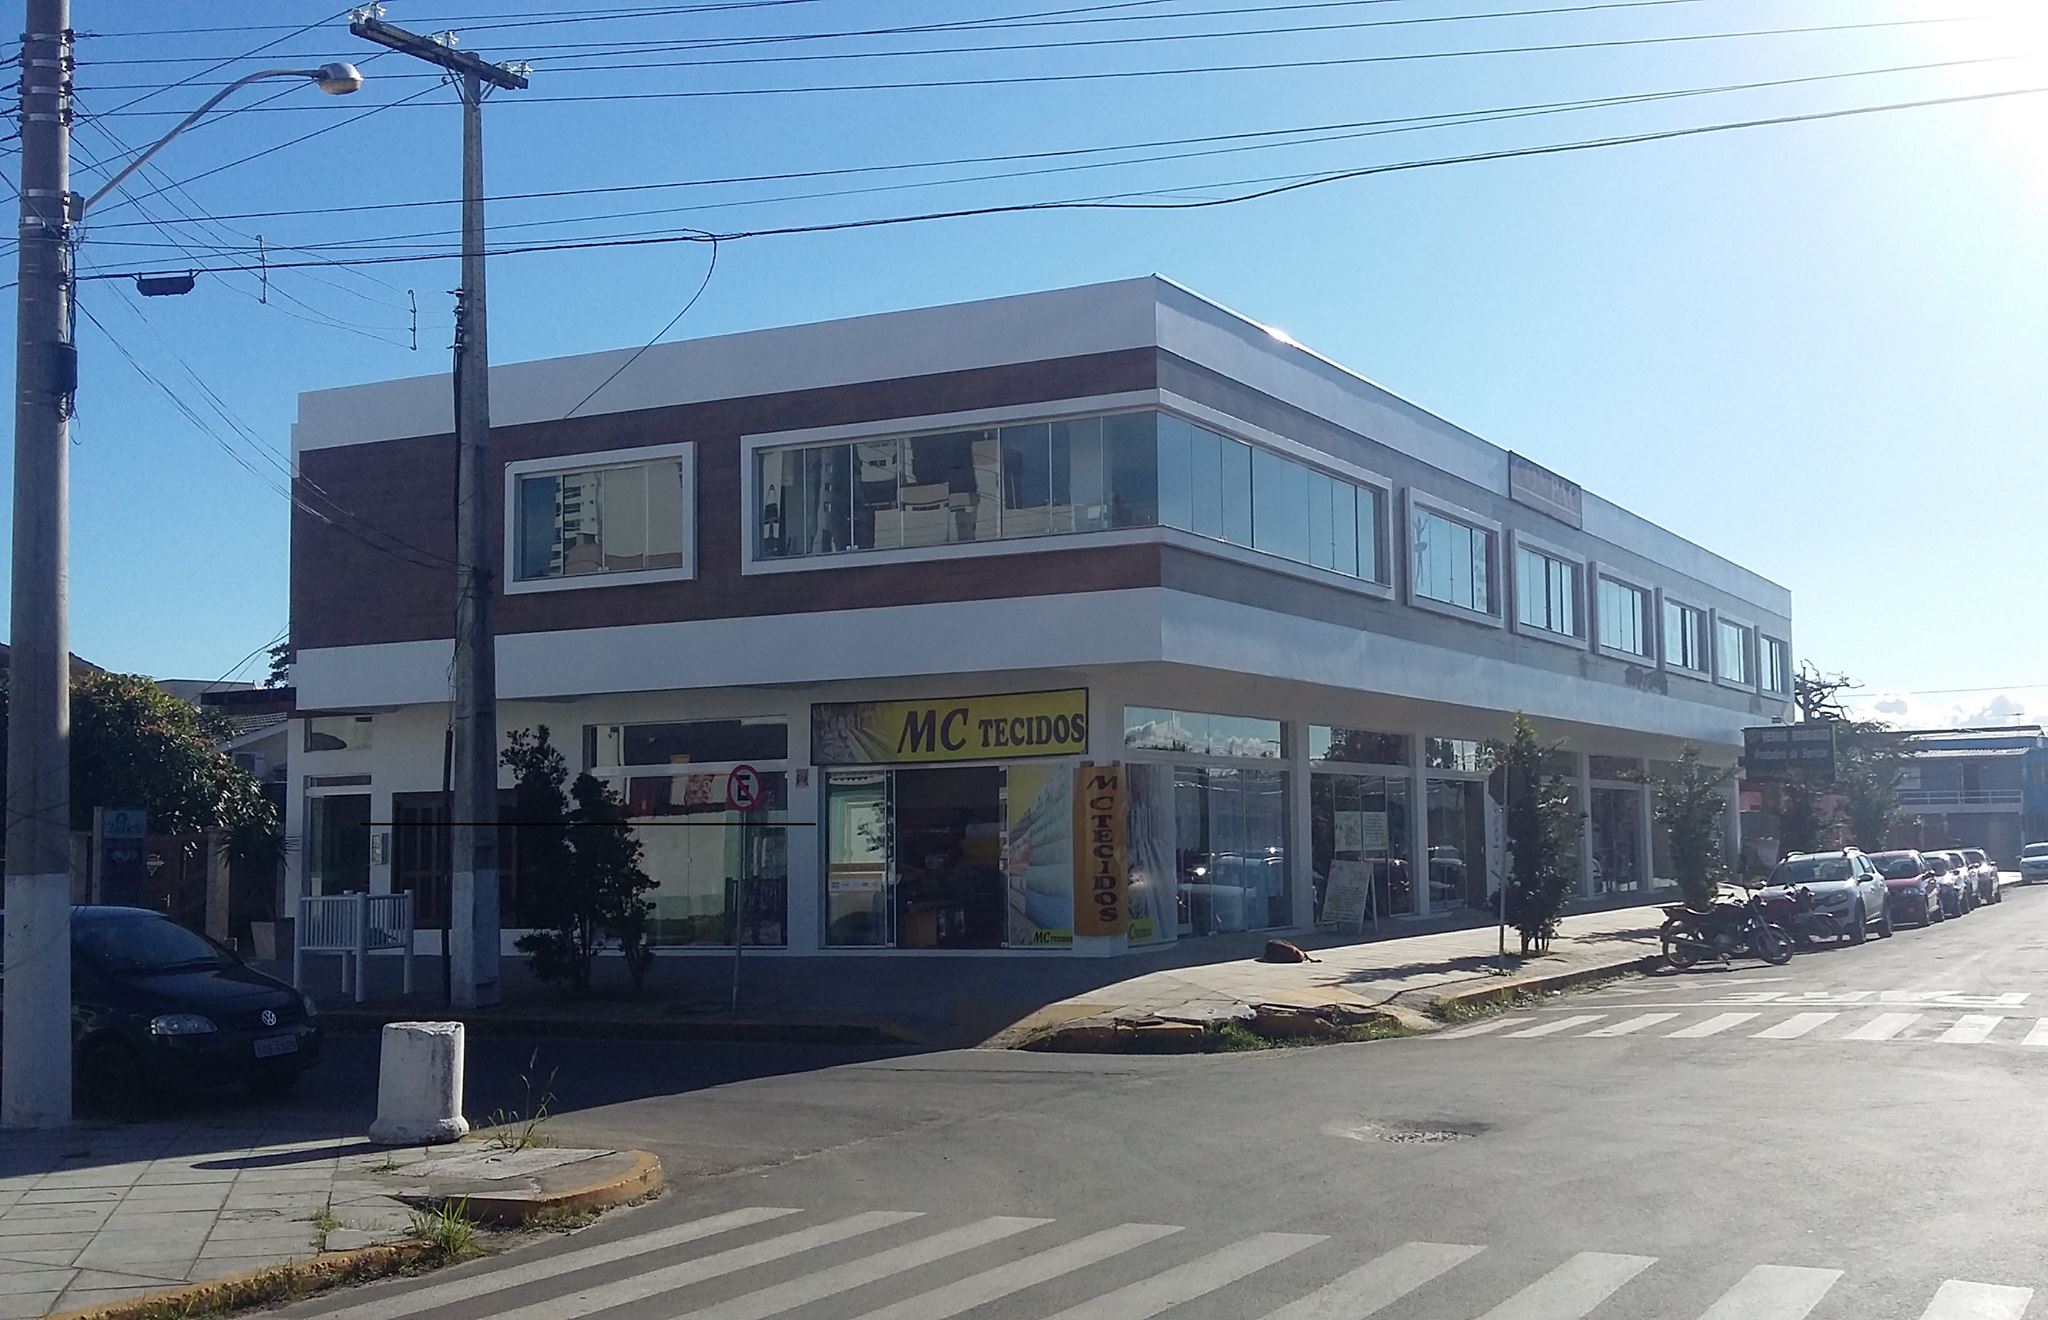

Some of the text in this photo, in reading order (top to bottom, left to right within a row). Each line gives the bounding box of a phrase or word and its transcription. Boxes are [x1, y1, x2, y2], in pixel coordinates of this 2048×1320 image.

[897, 708, 1085, 753] MC TECIDOS
[737, 774, 751, 802] E
